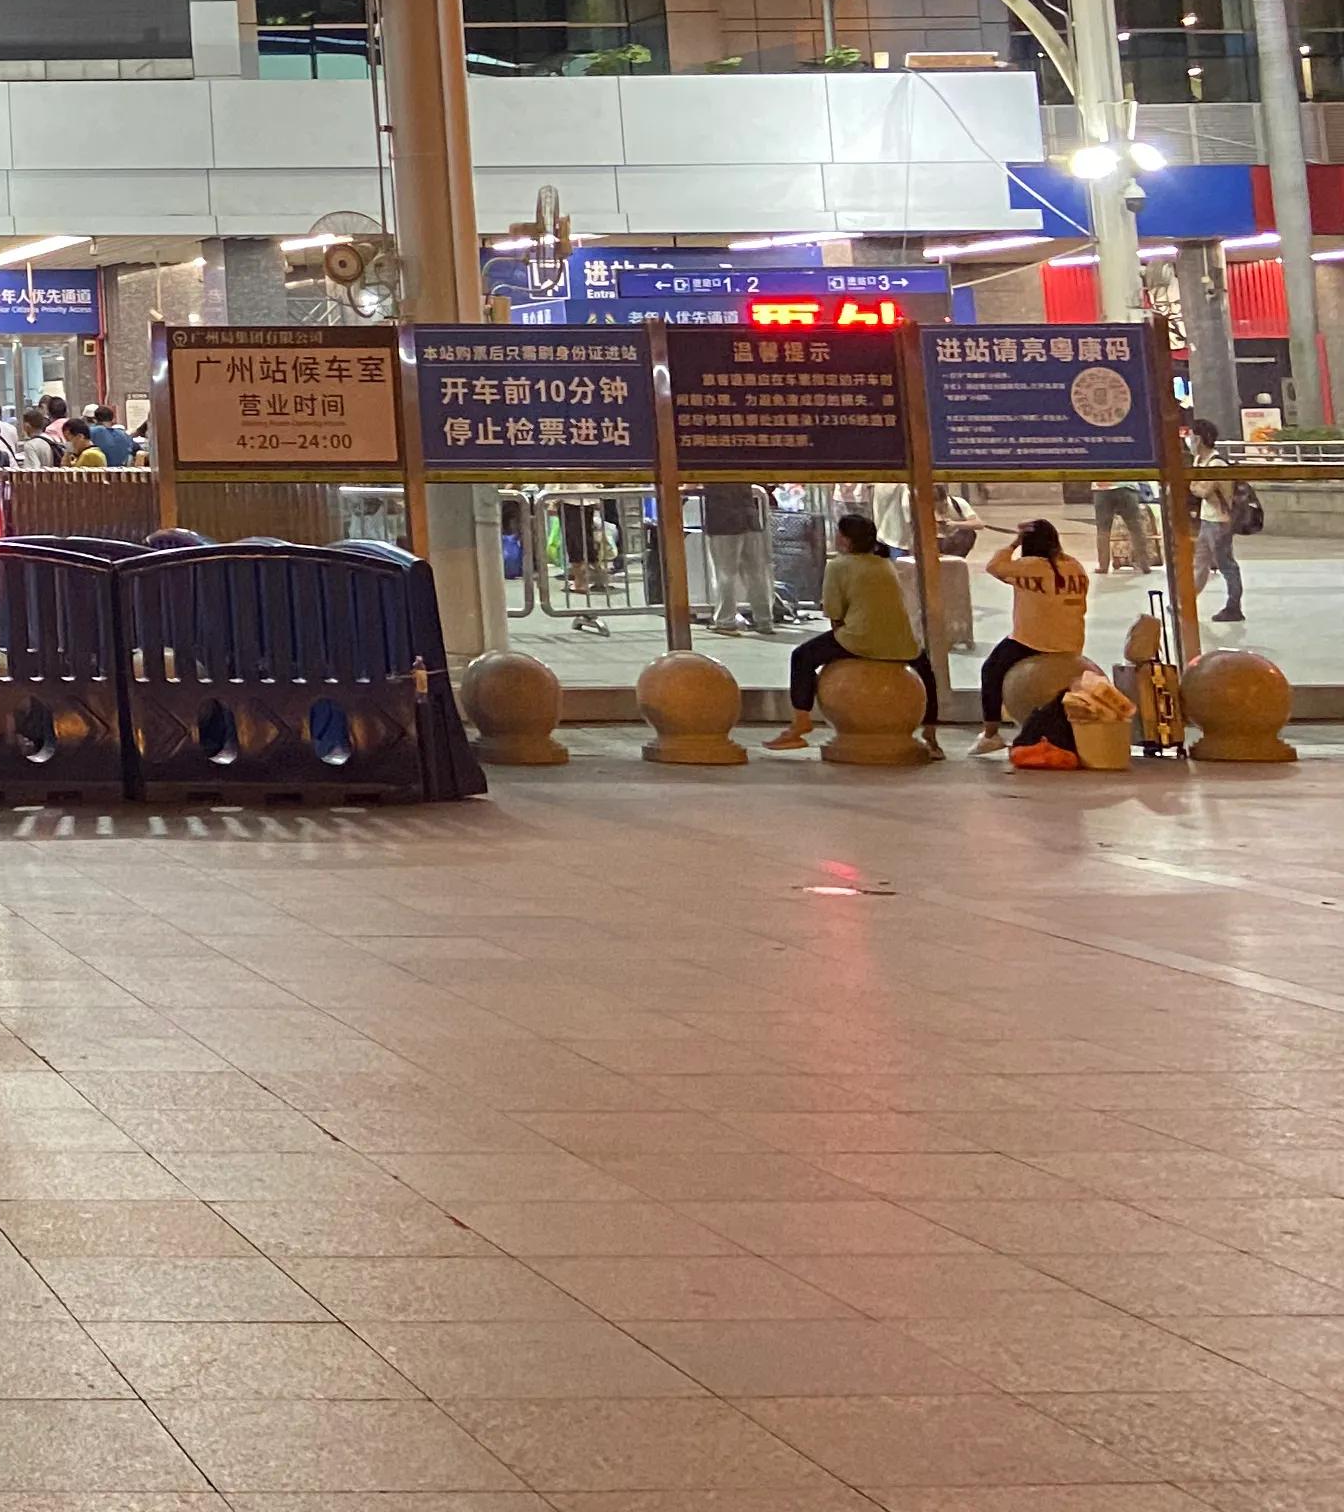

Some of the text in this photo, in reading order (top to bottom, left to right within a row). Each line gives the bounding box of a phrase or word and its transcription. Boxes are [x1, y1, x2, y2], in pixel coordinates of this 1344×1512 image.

[423, 345, 638, 361] 本站购票后只需刷身份证进站
[733, 341, 831, 363] 温馨提示
[936, 337, 1131, 363] 进站请亮粤康码
[193, 355, 386, 384] 广州站候车室
[440, 376, 629, 405] 开车前10分钟
[239, 394, 345, 417] 营业时间
[443, 417, 630, 447] 停止检票进站
